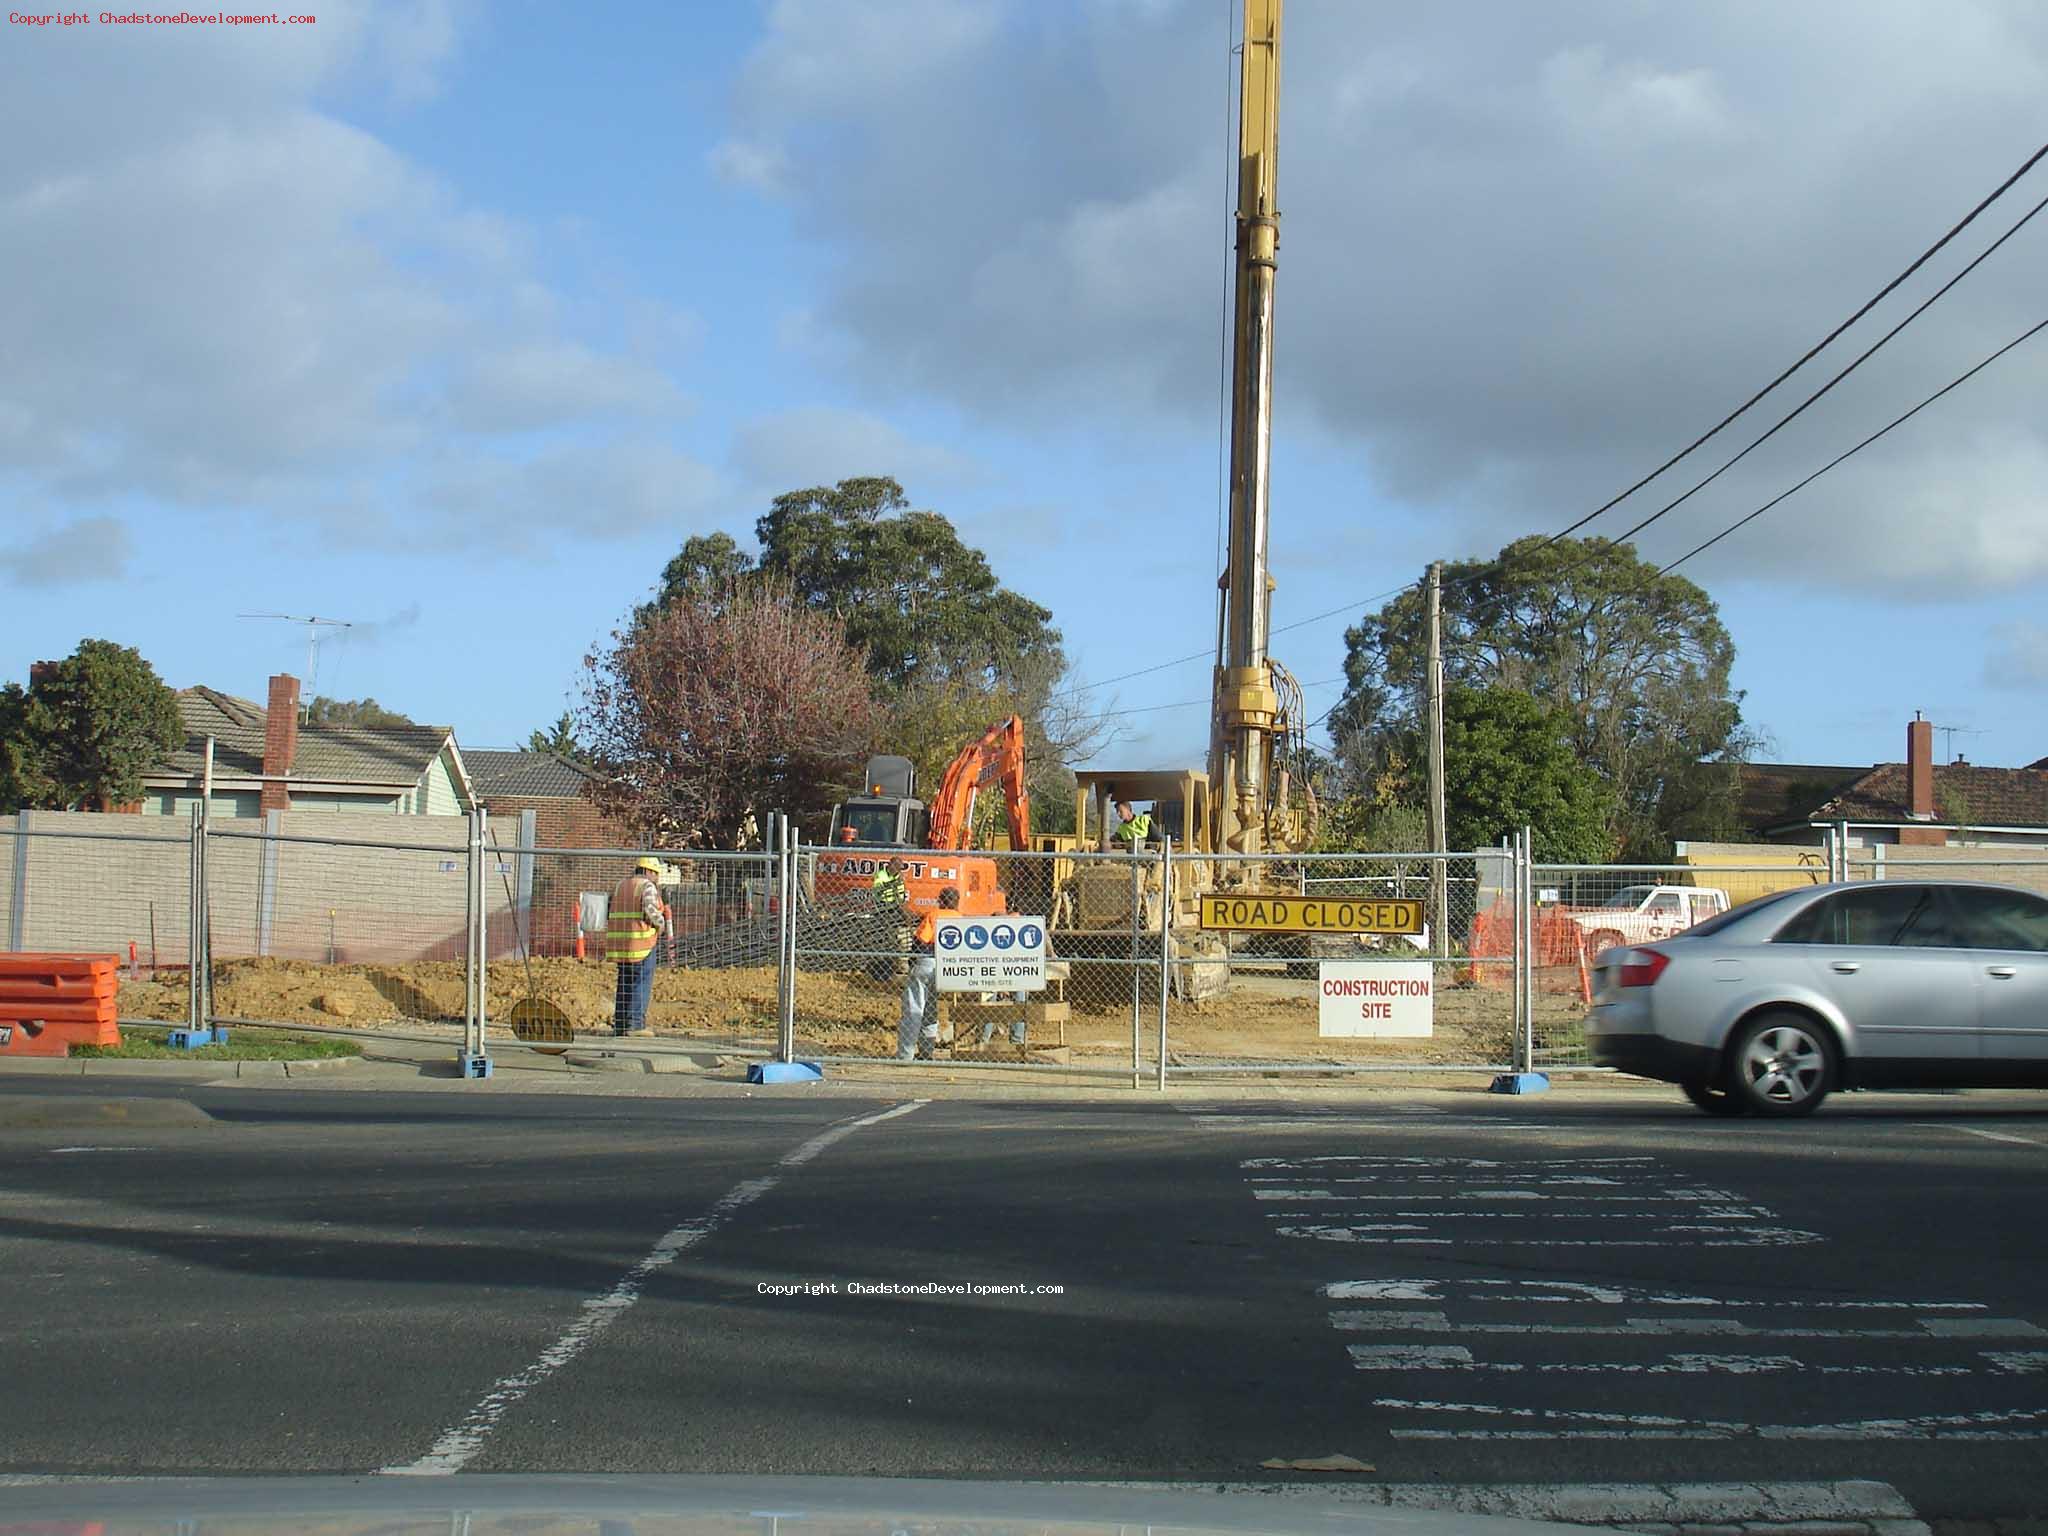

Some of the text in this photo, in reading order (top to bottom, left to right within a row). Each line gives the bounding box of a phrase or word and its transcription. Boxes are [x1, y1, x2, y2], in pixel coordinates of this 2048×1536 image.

[1213, 901, 1410, 928] ROAD CLOSED
[942, 966, 1039, 976] MUST BE WORN
[1323, 980, 1429, 997] CONSTRUCTION
[1361, 1003, 1392, 1018] SITE
